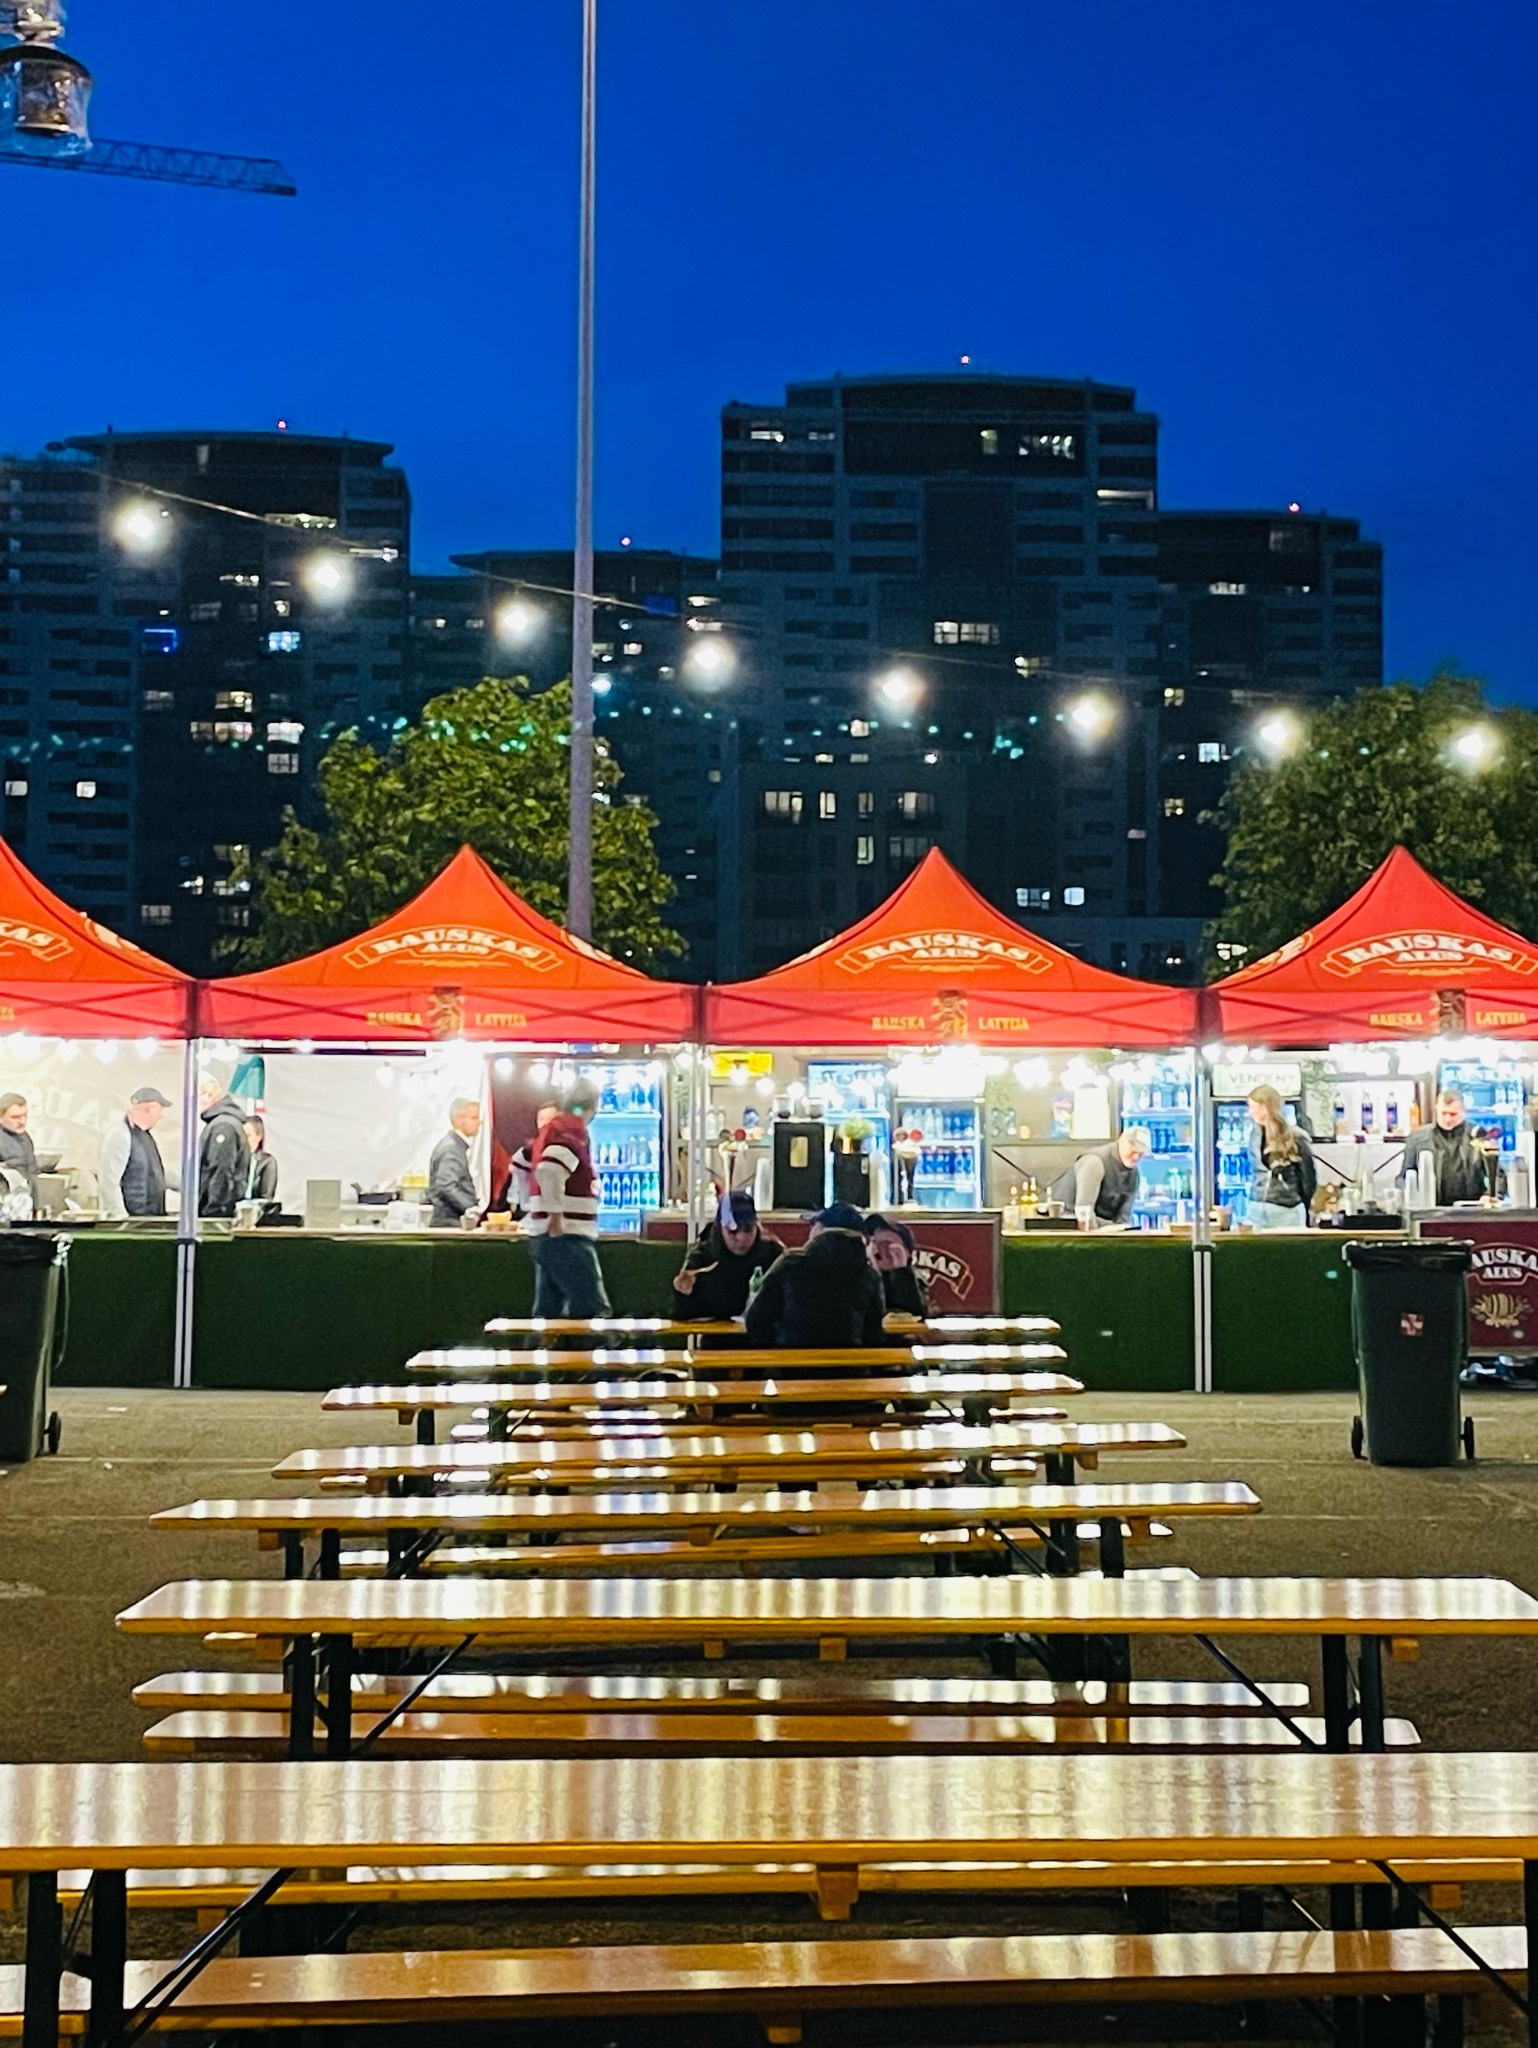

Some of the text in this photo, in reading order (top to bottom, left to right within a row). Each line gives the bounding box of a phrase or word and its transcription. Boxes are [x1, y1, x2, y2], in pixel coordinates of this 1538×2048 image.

[370, 927, 543, 959] BAUSKAS
[420, 943, 490, 955] ALUS
[859, 933, 1030, 961] BAUSKAS
[1340, 934, 1514, 964] BAUSKAS
[911, 948, 979, 959] ALUS
[1396, 950, 1465, 962] ALUS
[1471, 1248, 1538, 1272] AUSKA
[1482, 1266, 1522, 1280] ALUS
